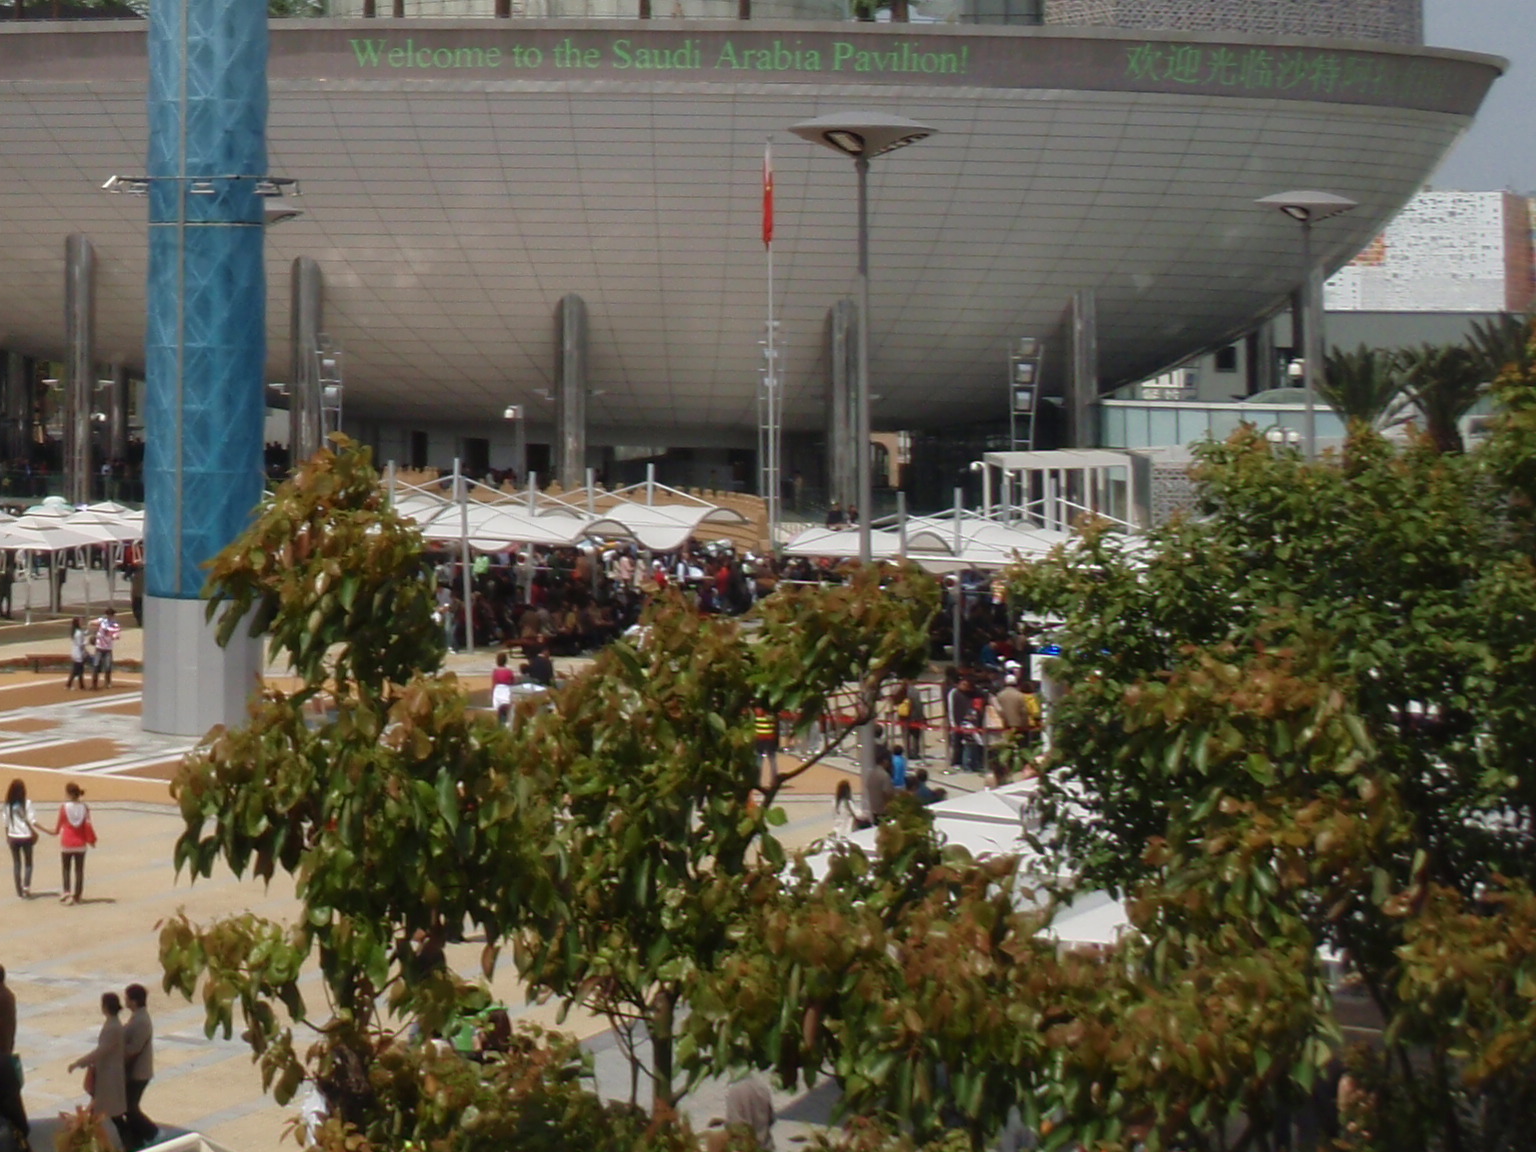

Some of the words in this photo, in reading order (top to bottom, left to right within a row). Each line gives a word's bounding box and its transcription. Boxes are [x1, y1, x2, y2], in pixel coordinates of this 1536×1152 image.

[349, 38, 502, 69] Welcome
[511, 42, 543, 69] to
[553, 38, 602, 69] the
[612, 39, 702, 71] Saudi
[716, 41, 821, 72] Arabia
[832, 42, 969, 74] Pavilion!
